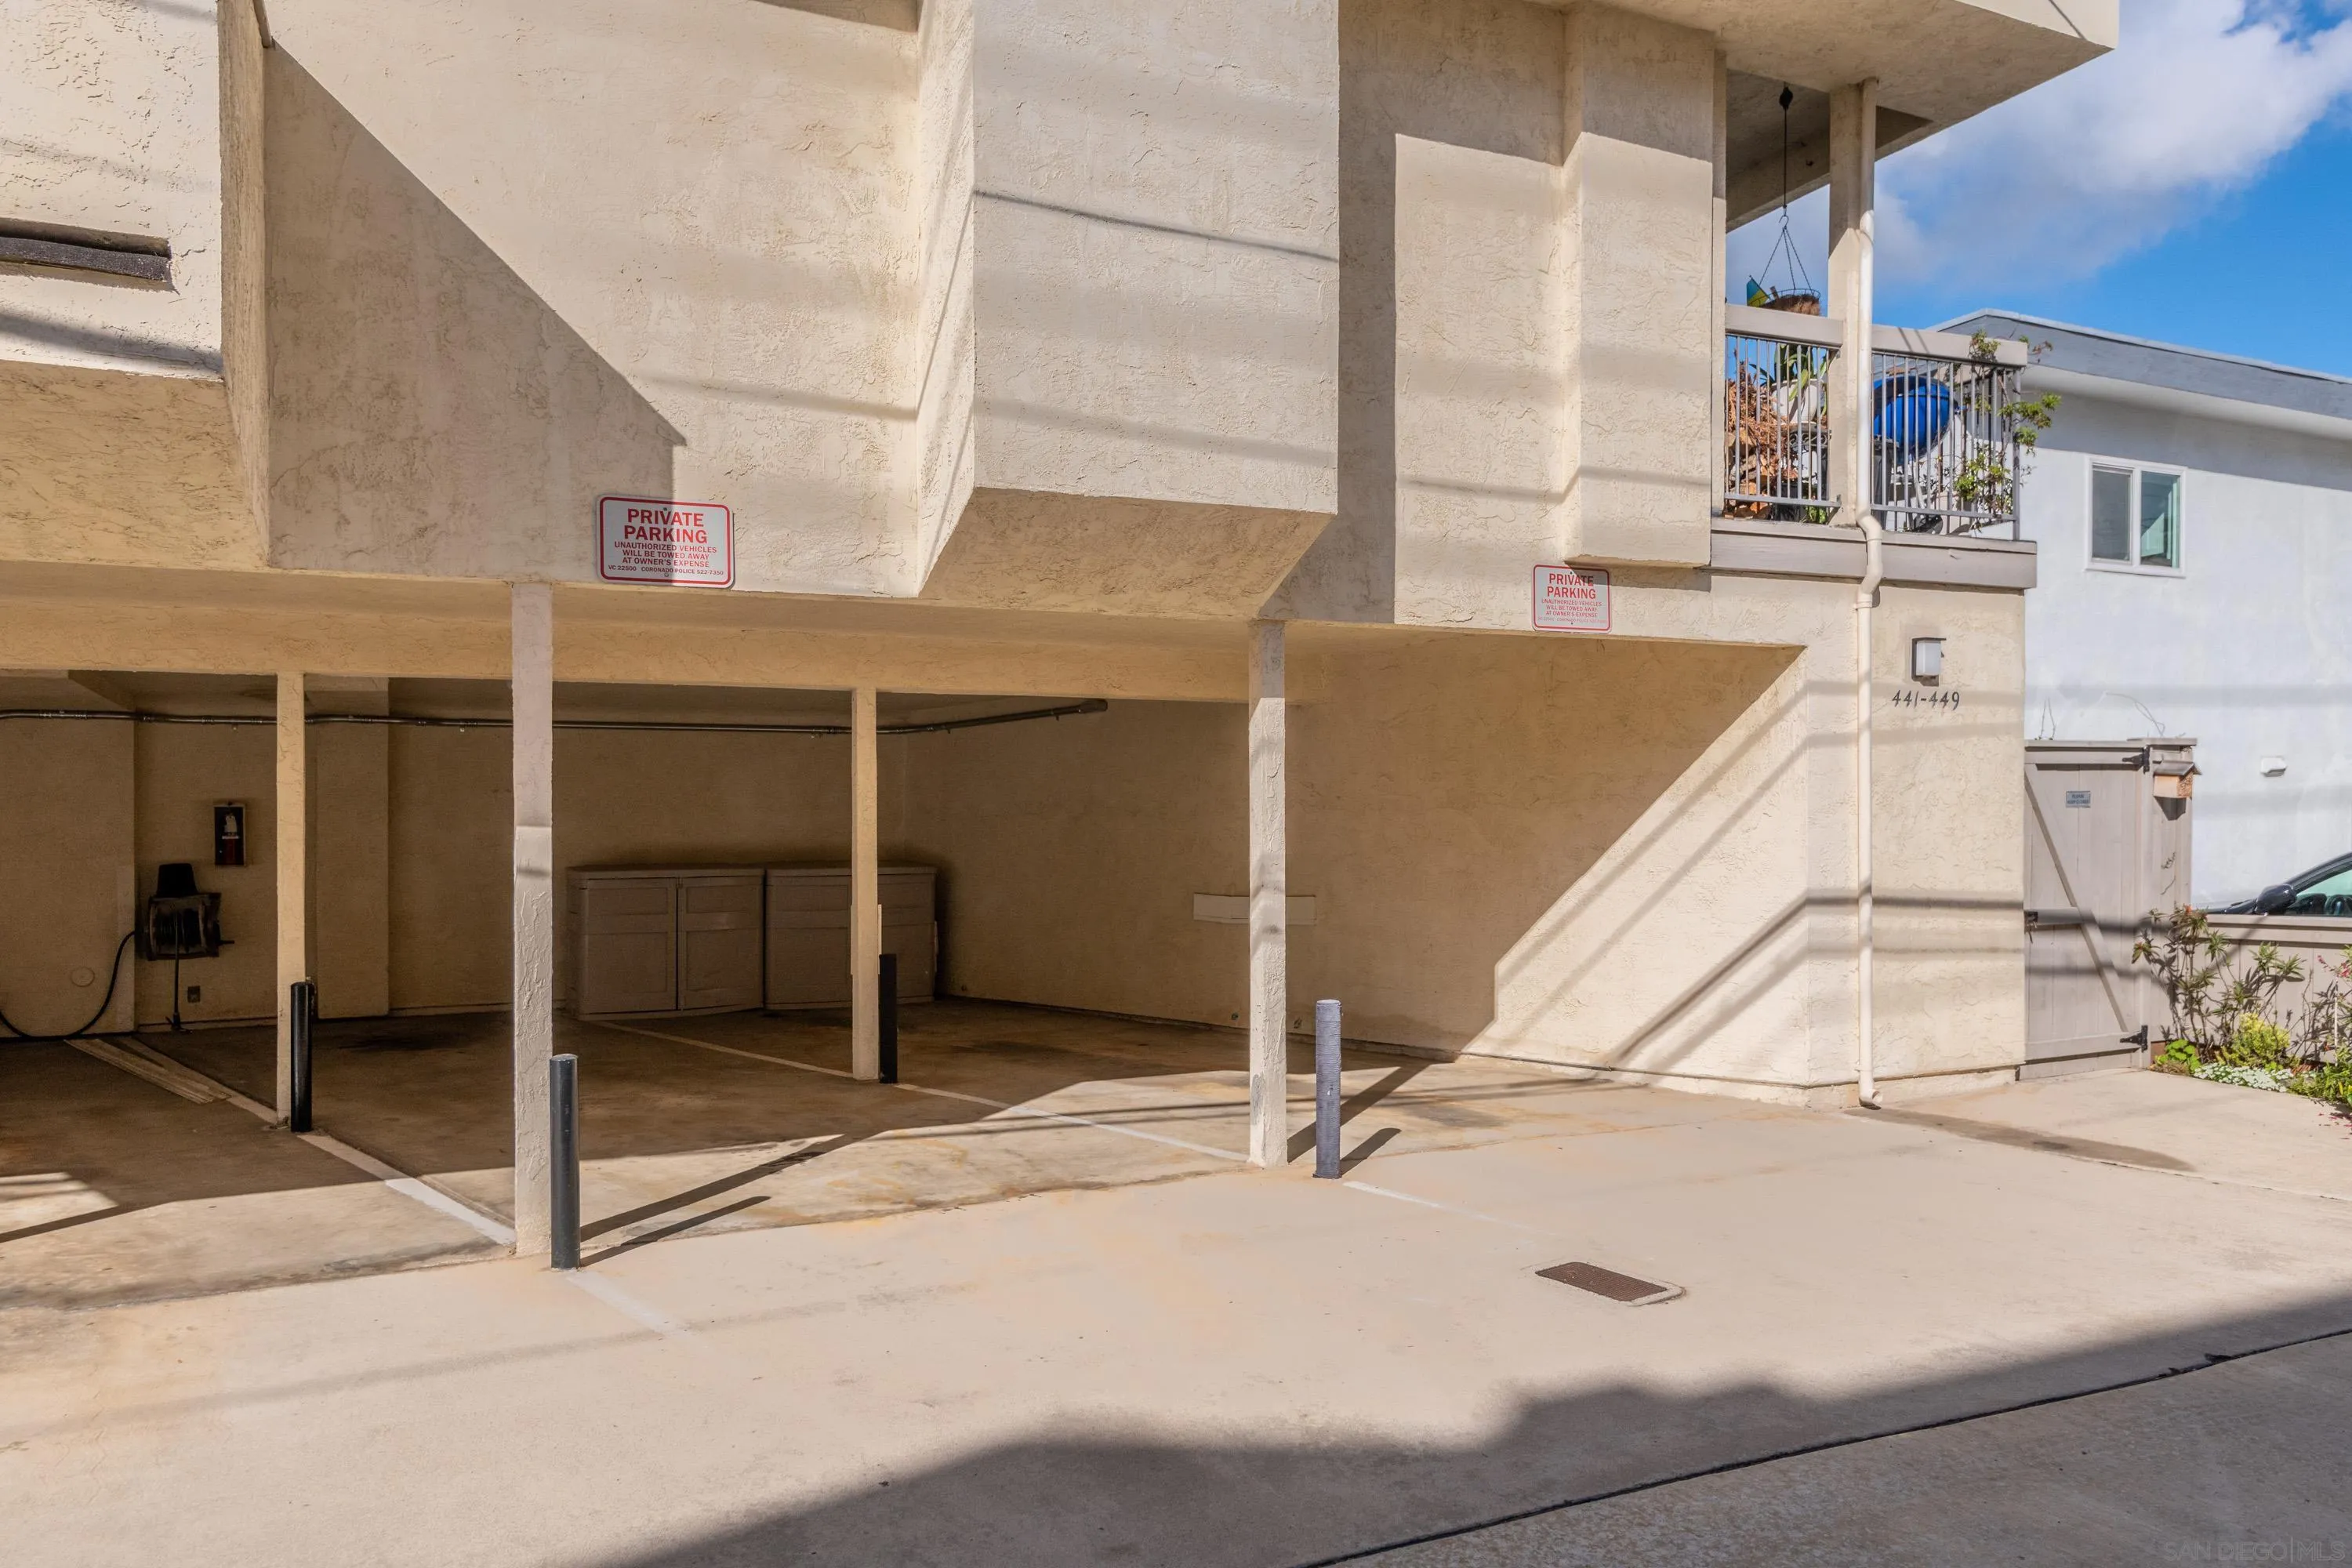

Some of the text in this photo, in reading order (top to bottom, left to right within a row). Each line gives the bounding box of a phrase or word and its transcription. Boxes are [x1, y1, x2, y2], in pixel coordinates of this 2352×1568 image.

[627, 508, 704, 527] PRIVATE
[624, 524, 707, 543] PARKING
[614, 541, 677, 551] UNAUTHORIZED
[1549, 573, 1594, 586] PRIVATE
[1547, 586, 1596, 599] PARKING
[1892, 689, 1960, 710] 441-449
